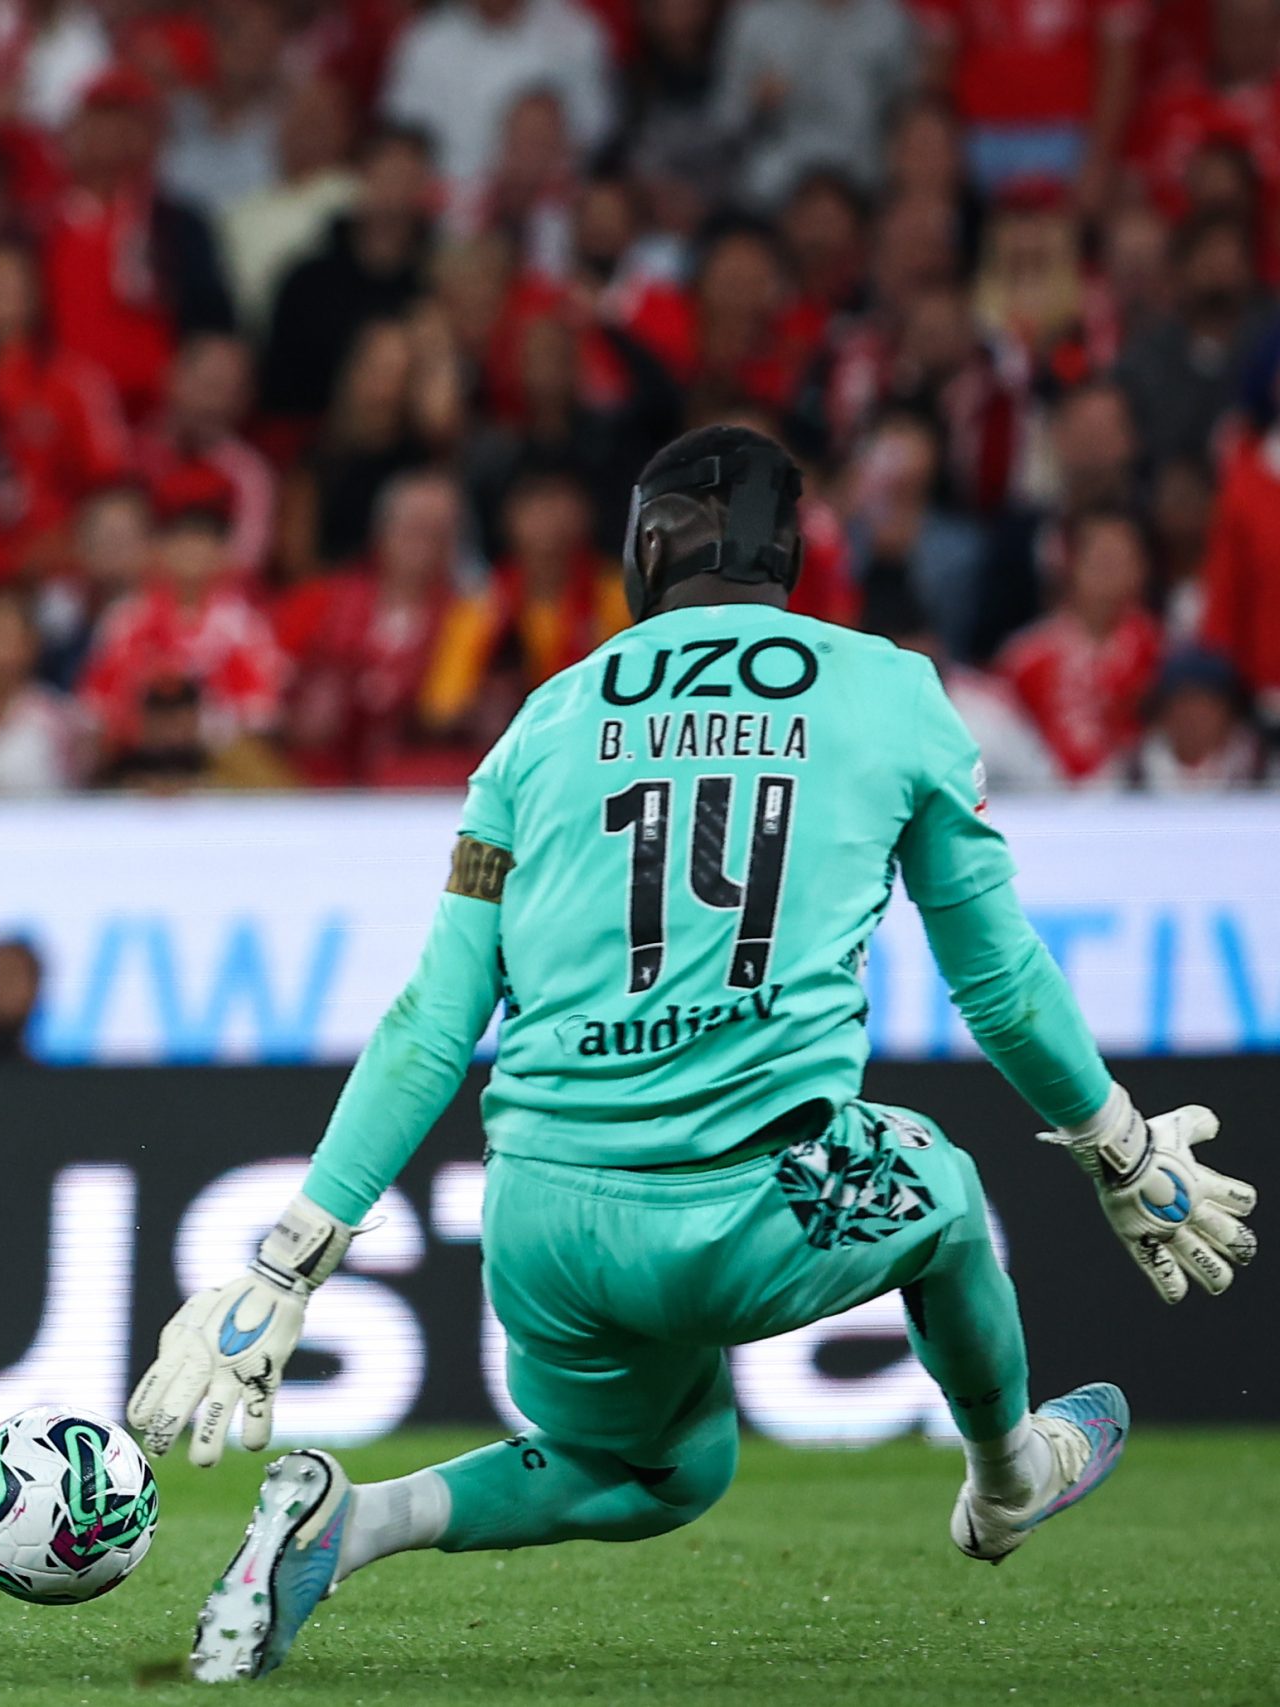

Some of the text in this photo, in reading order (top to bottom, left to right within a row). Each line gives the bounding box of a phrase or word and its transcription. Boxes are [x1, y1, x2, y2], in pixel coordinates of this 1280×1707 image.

[600, 636, 819, 706] UZO
[598, 711, 808, 762] B. VARELA
[603, 772, 797, 994] 14
